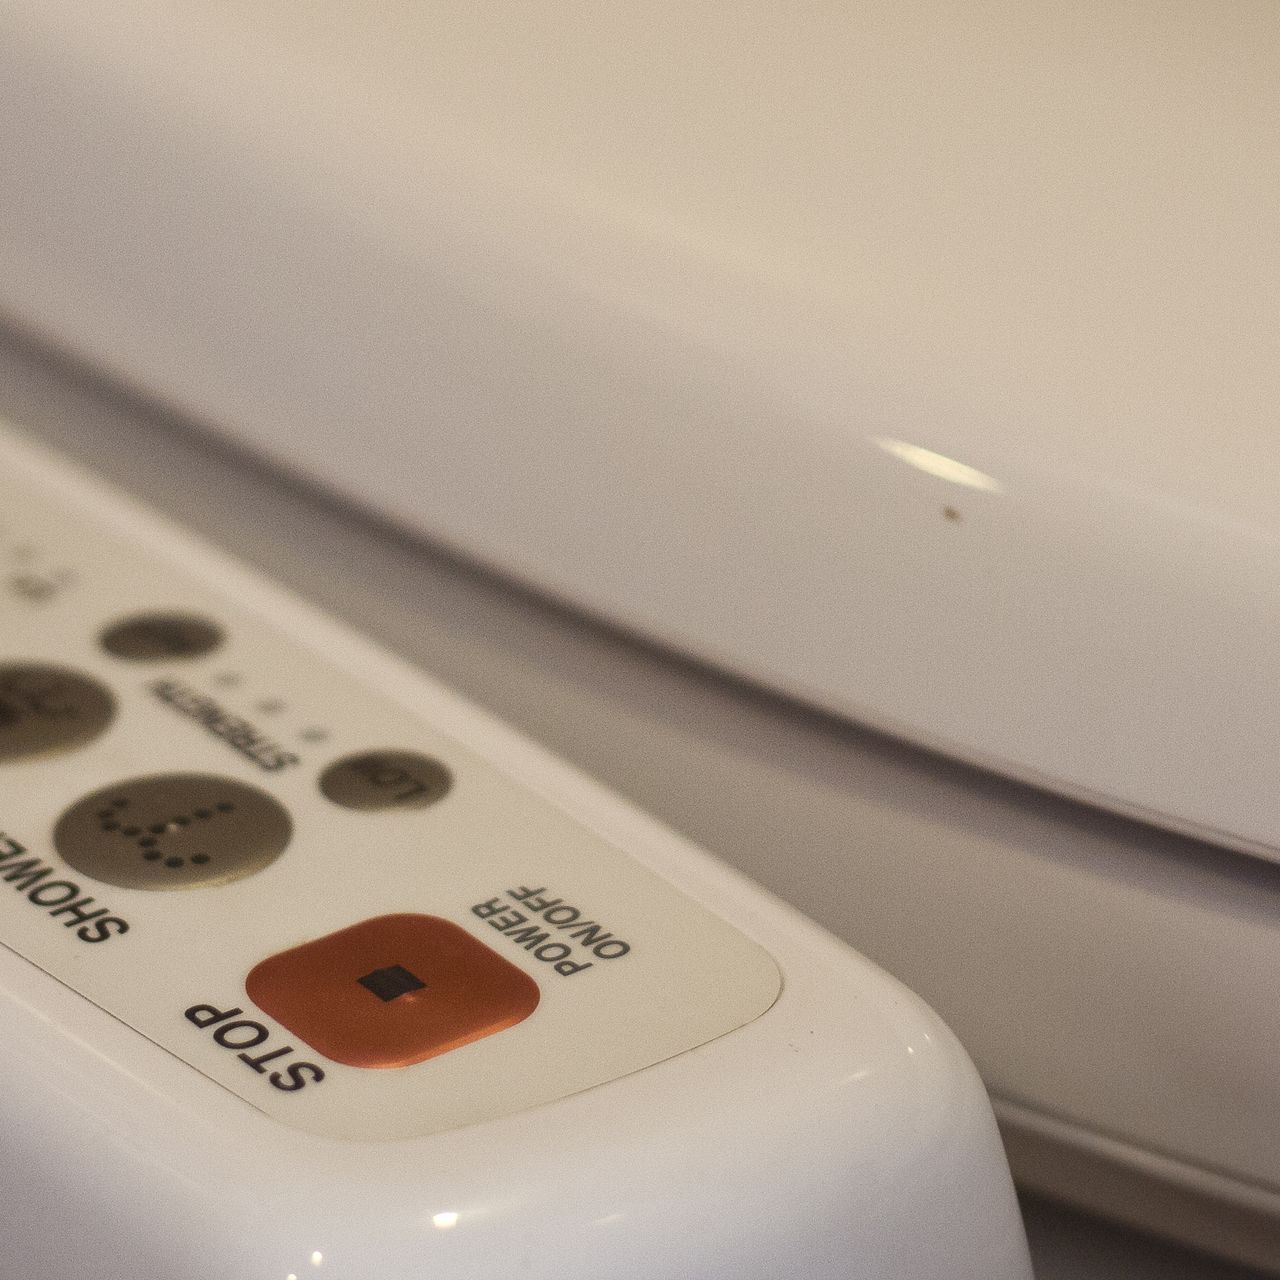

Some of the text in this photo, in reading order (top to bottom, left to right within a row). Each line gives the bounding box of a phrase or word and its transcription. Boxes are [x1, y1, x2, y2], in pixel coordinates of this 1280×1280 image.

[471, 897, 593, 977] POWER
[506, 885, 631, 959] ON/OFF
[184, 1003, 326, 1092] STOP
